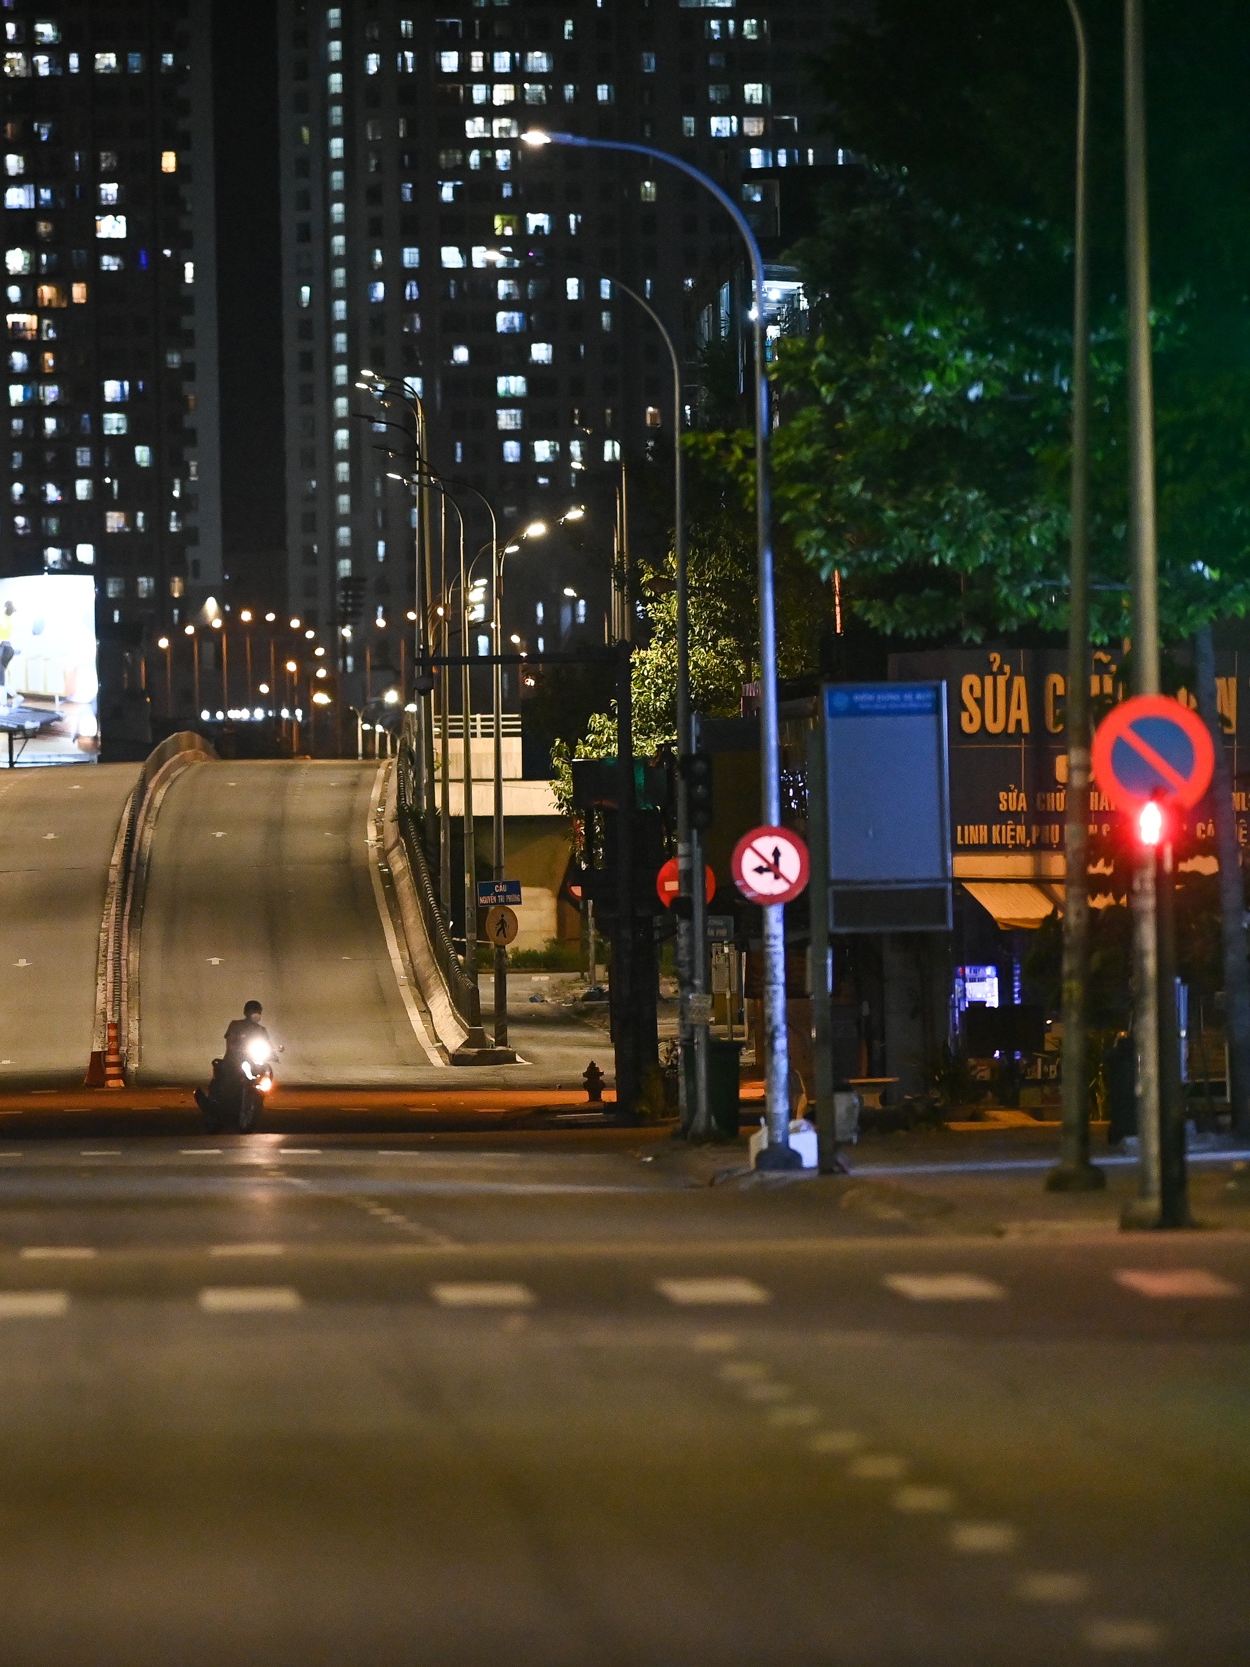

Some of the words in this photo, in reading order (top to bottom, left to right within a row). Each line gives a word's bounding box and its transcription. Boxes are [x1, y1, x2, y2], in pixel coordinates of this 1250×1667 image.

[960, 652, 1030, 735] SỬA
[999, 784, 1028, 812] SỬA
[1036, 784, 1067, 812] CHỮ
[956, 824, 988, 845] LINH
